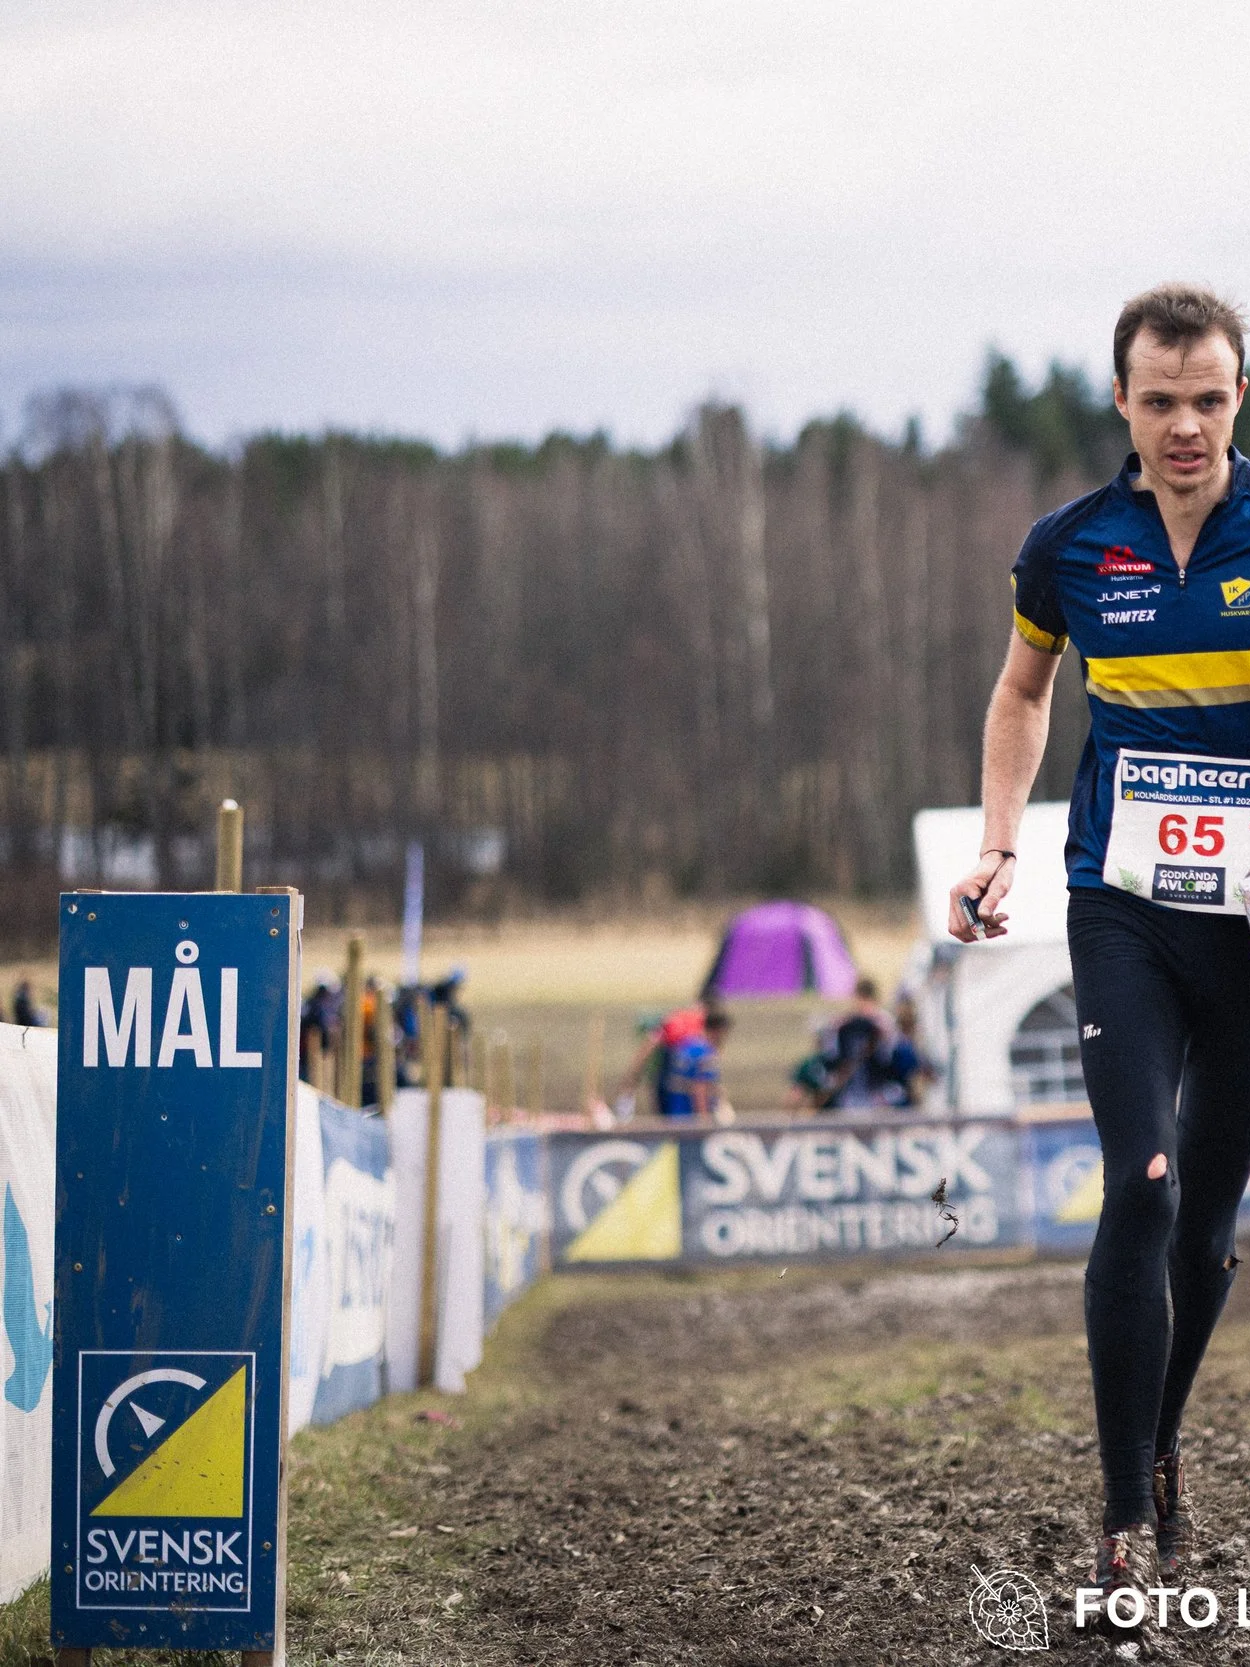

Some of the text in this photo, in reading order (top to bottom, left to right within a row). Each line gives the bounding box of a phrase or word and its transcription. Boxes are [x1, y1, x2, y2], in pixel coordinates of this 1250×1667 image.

[1098, 563, 1151, 573] KVANTUM
[1111, 574, 1144, 582] Huskvarna
[1097, 588, 1152, 603] JUNET
[1228, 586, 1239, 594] IK
[1101, 609, 1157, 625] TRIMTEX
[1134, 790, 1203, 803] KOLMÅRDSKAVLEN
[1208, 795, 1223, 804] STL
[1223, 796, 1234, 804] #1
[1158, 813, 1226, 857] 65
[1159, 869, 1219, 882] GODKÄNDA
[83, 940, 263, 1068] MÅL
[700, 1124, 993, 1202] SVENSK
[86, 1529, 243, 1565] SVENSK
[85, 1570, 244, 1593] ORIENTERING
